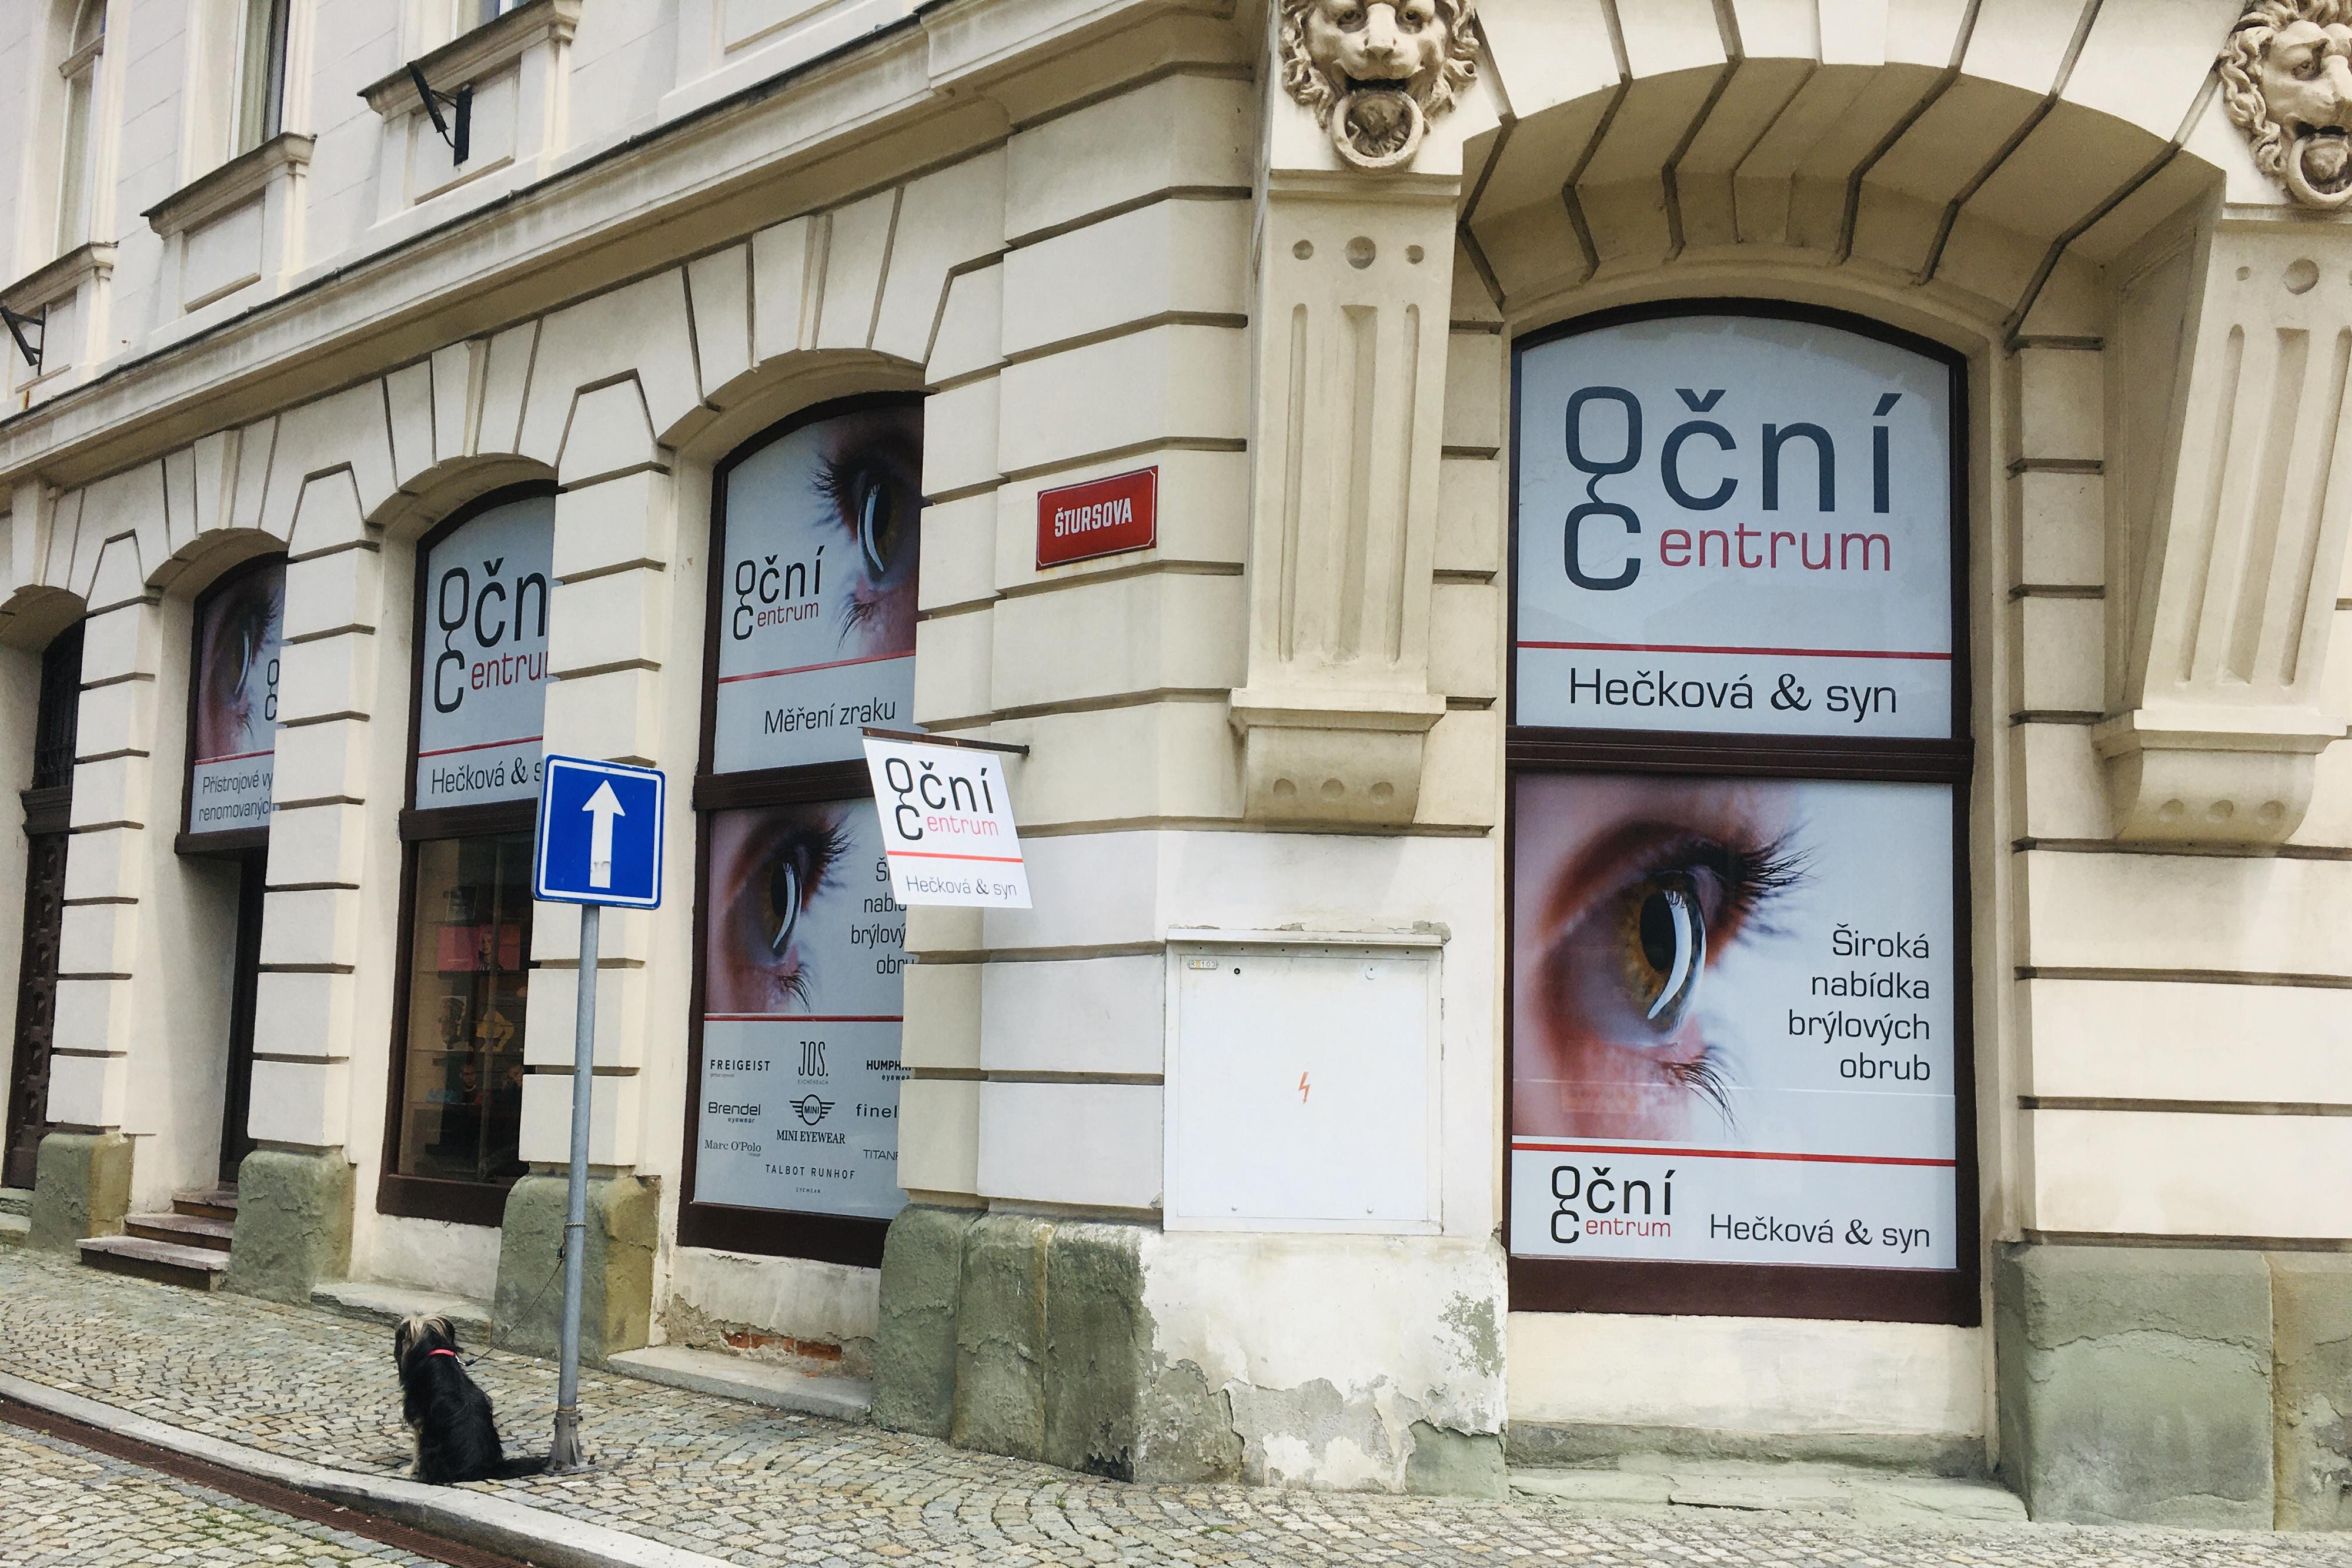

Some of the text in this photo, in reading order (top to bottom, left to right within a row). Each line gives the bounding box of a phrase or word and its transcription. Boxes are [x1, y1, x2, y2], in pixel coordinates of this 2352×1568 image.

[1055, 497, 1132, 537] ŠTURSOVA
[1564, 503, 1892, 591] Centrum
[733, 602, 819, 640] Centrum
[434, 650, 549, 714] Centru
[1571, 668, 1897, 723] Hečková & syn
[765, 697, 896, 734] Měření zraku
[203, 770, 259, 795] Přístrojové
[431, 761, 505, 795] Hečková
[511, 757, 528, 784] &
[896, 804, 999, 840] Centrum
[906, 875, 1017, 900] Hečková & syn
[1833, 924, 1930, 959] Široká
[1812, 971, 1930, 1000] nabídka
[1789, 1009, 1930, 1046] brýlových
[710, 1059, 770, 1071] FREIGEIST
[799, 1041, 829, 1076] JOS.
[867, 1060, 911, 1071] HUMPH
[1840, 1054, 1932, 1081] obrub
[709, 1102, 761, 1115] Brendel
[804, 1106, 820, 1114] MINI
[704, 1139, 761, 1152] Marc O'Polo
[777, 1129, 846, 1144] MINI EYEWEAR
[766, 1165, 854, 1179] TALBOT RUNHOF
[1551, 1210, 1671, 1243] Centrum
[1710, 1214, 1930, 1253] Hečková & syn
